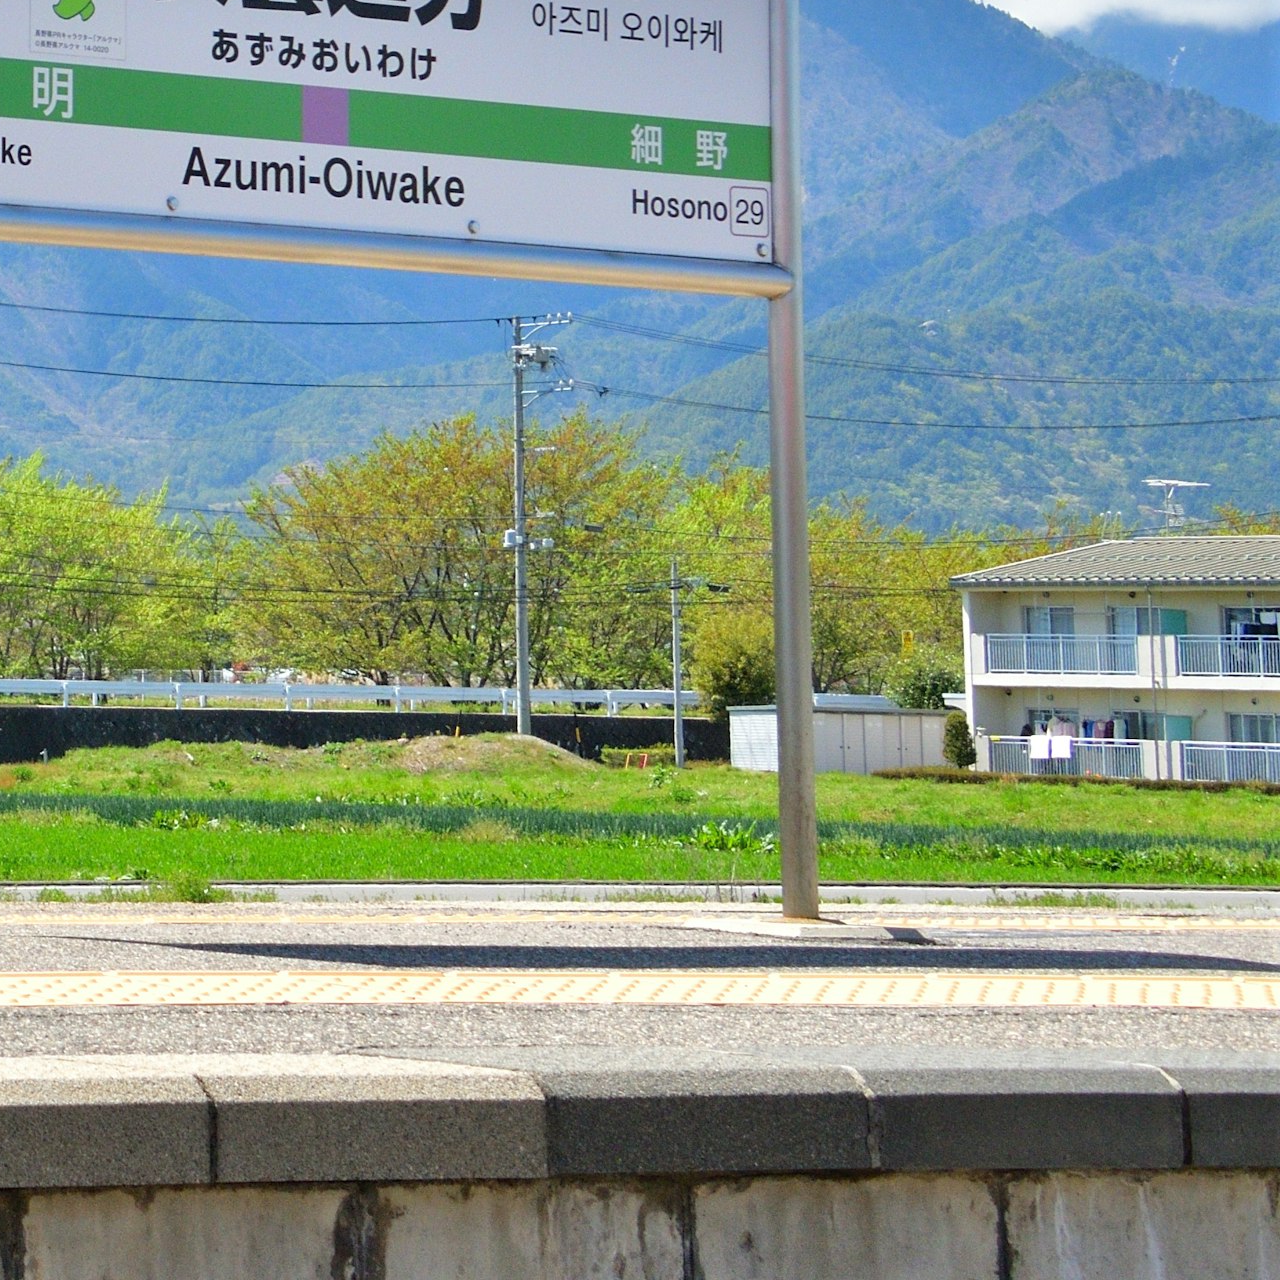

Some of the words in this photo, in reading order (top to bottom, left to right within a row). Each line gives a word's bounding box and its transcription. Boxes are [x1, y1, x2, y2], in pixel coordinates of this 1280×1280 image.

[532, 1, 608, 42] 아즈미
[620, 12, 723, 54] 오이와케
[211, 28, 437, 81] あずみおいわけ
[182, 146, 465, 207] Azumi-Oiwake
[632, 188, 728, 222] Hosono
[735, 199, 764, 225] 29
